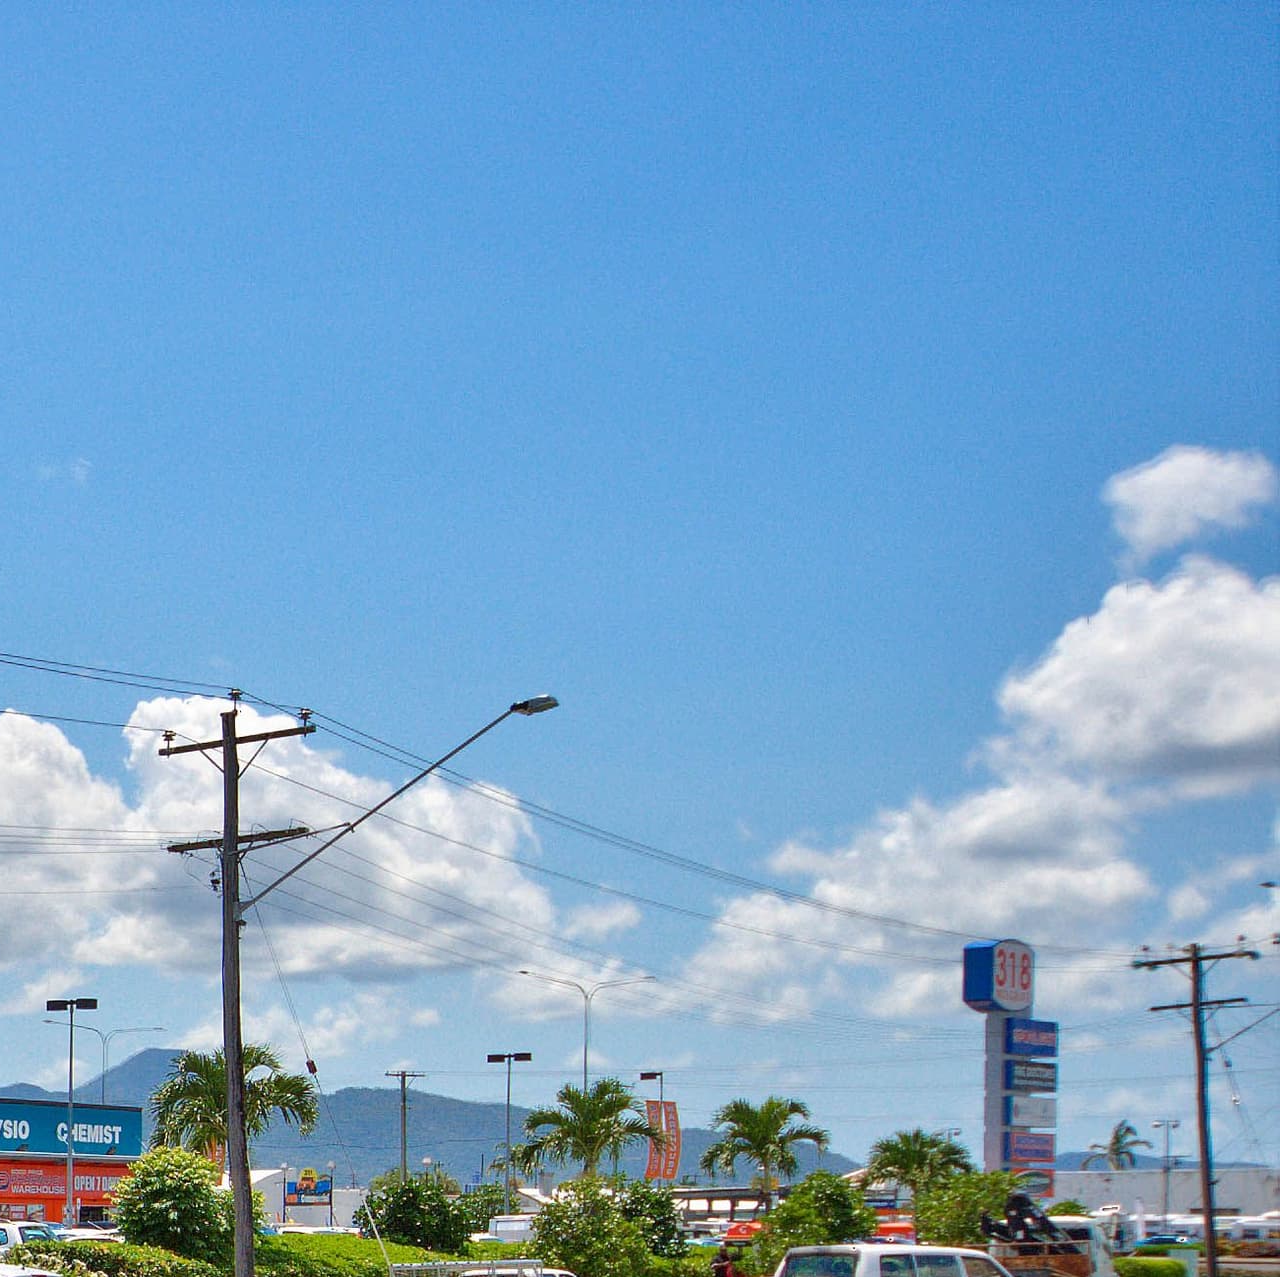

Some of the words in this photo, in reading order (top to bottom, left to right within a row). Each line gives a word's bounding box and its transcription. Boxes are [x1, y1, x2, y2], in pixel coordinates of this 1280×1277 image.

[995, 948, 1032, 990] 318
[57, 1122, 122, 1144] CHEMIST
[11, 1184, 66, 1194] WAREHOUSE
[74, 1176, 94, 1191] OPEN
[95, 1176, 101, 1191] 7
